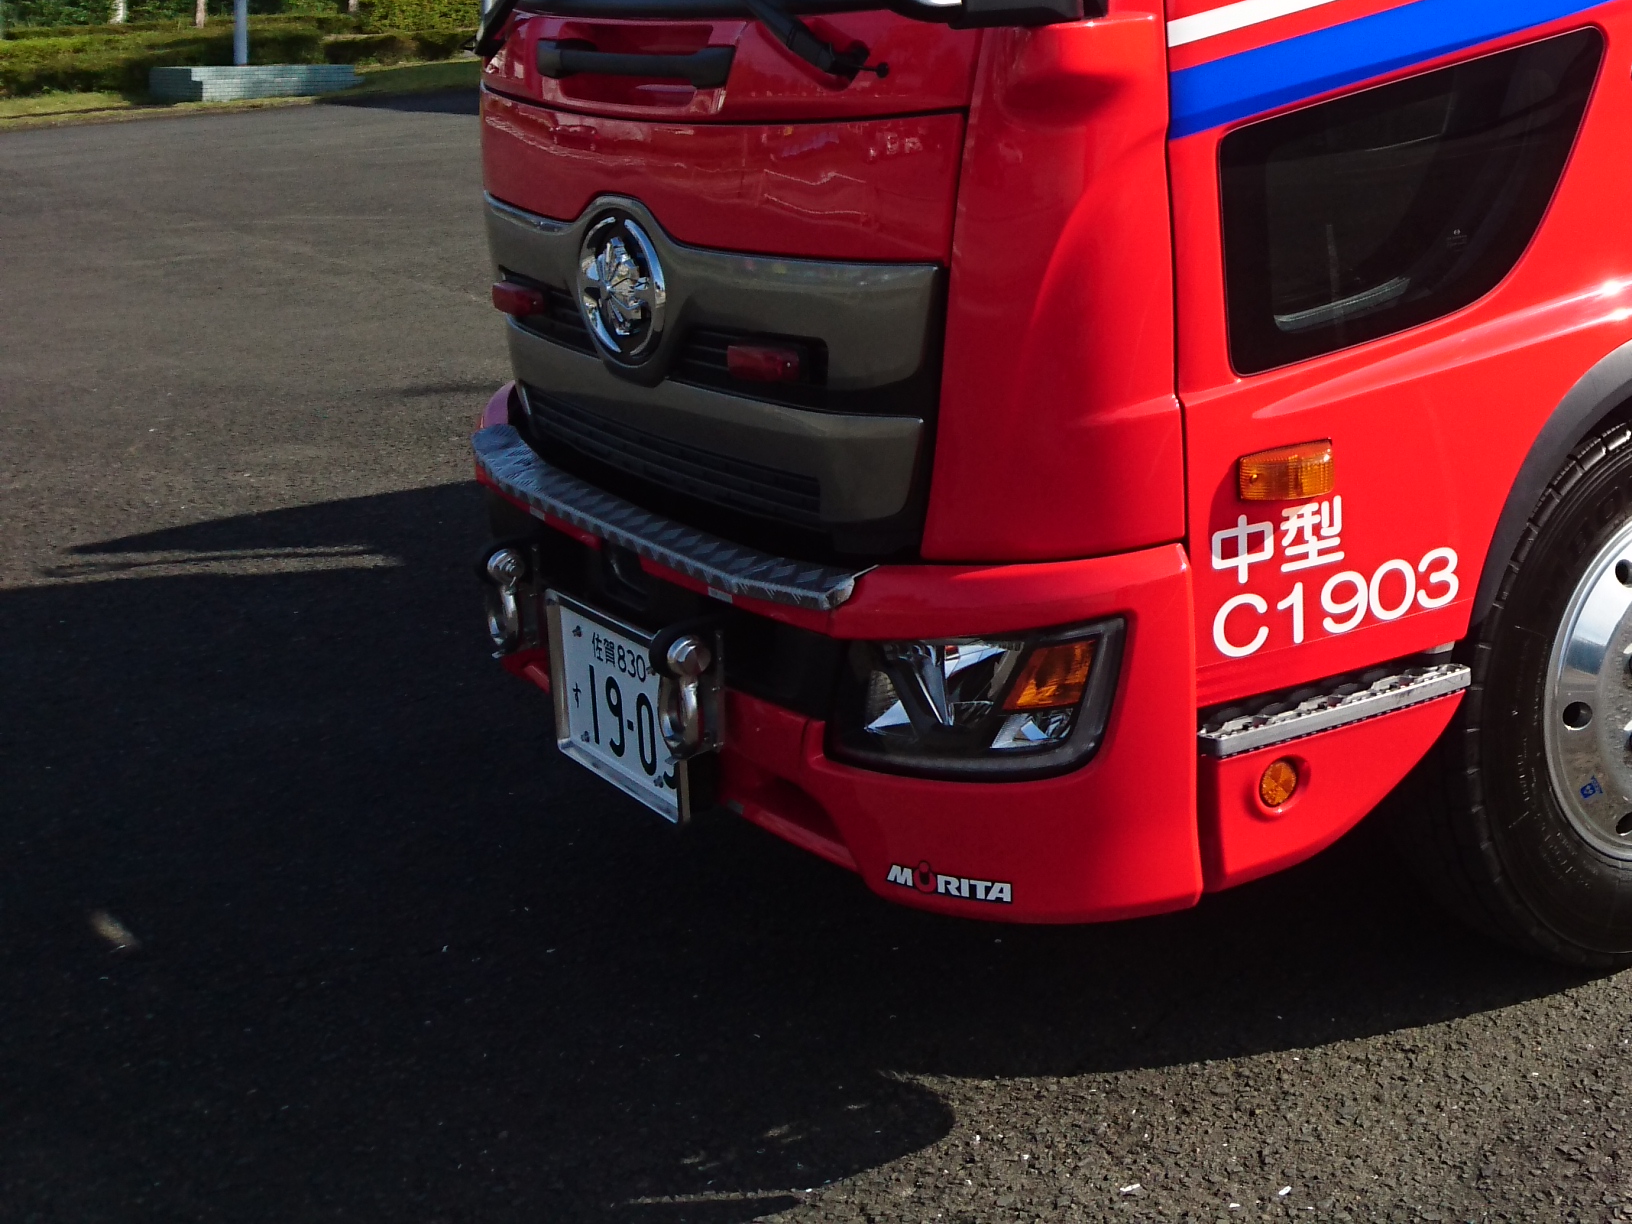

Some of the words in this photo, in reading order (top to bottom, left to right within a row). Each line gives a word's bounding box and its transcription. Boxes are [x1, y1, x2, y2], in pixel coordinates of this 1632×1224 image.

[1211, 495, 1345, 584] 中型
[1212, 547, 1460, 658] C1903
[887, 861, 1013, 903] MORITA
